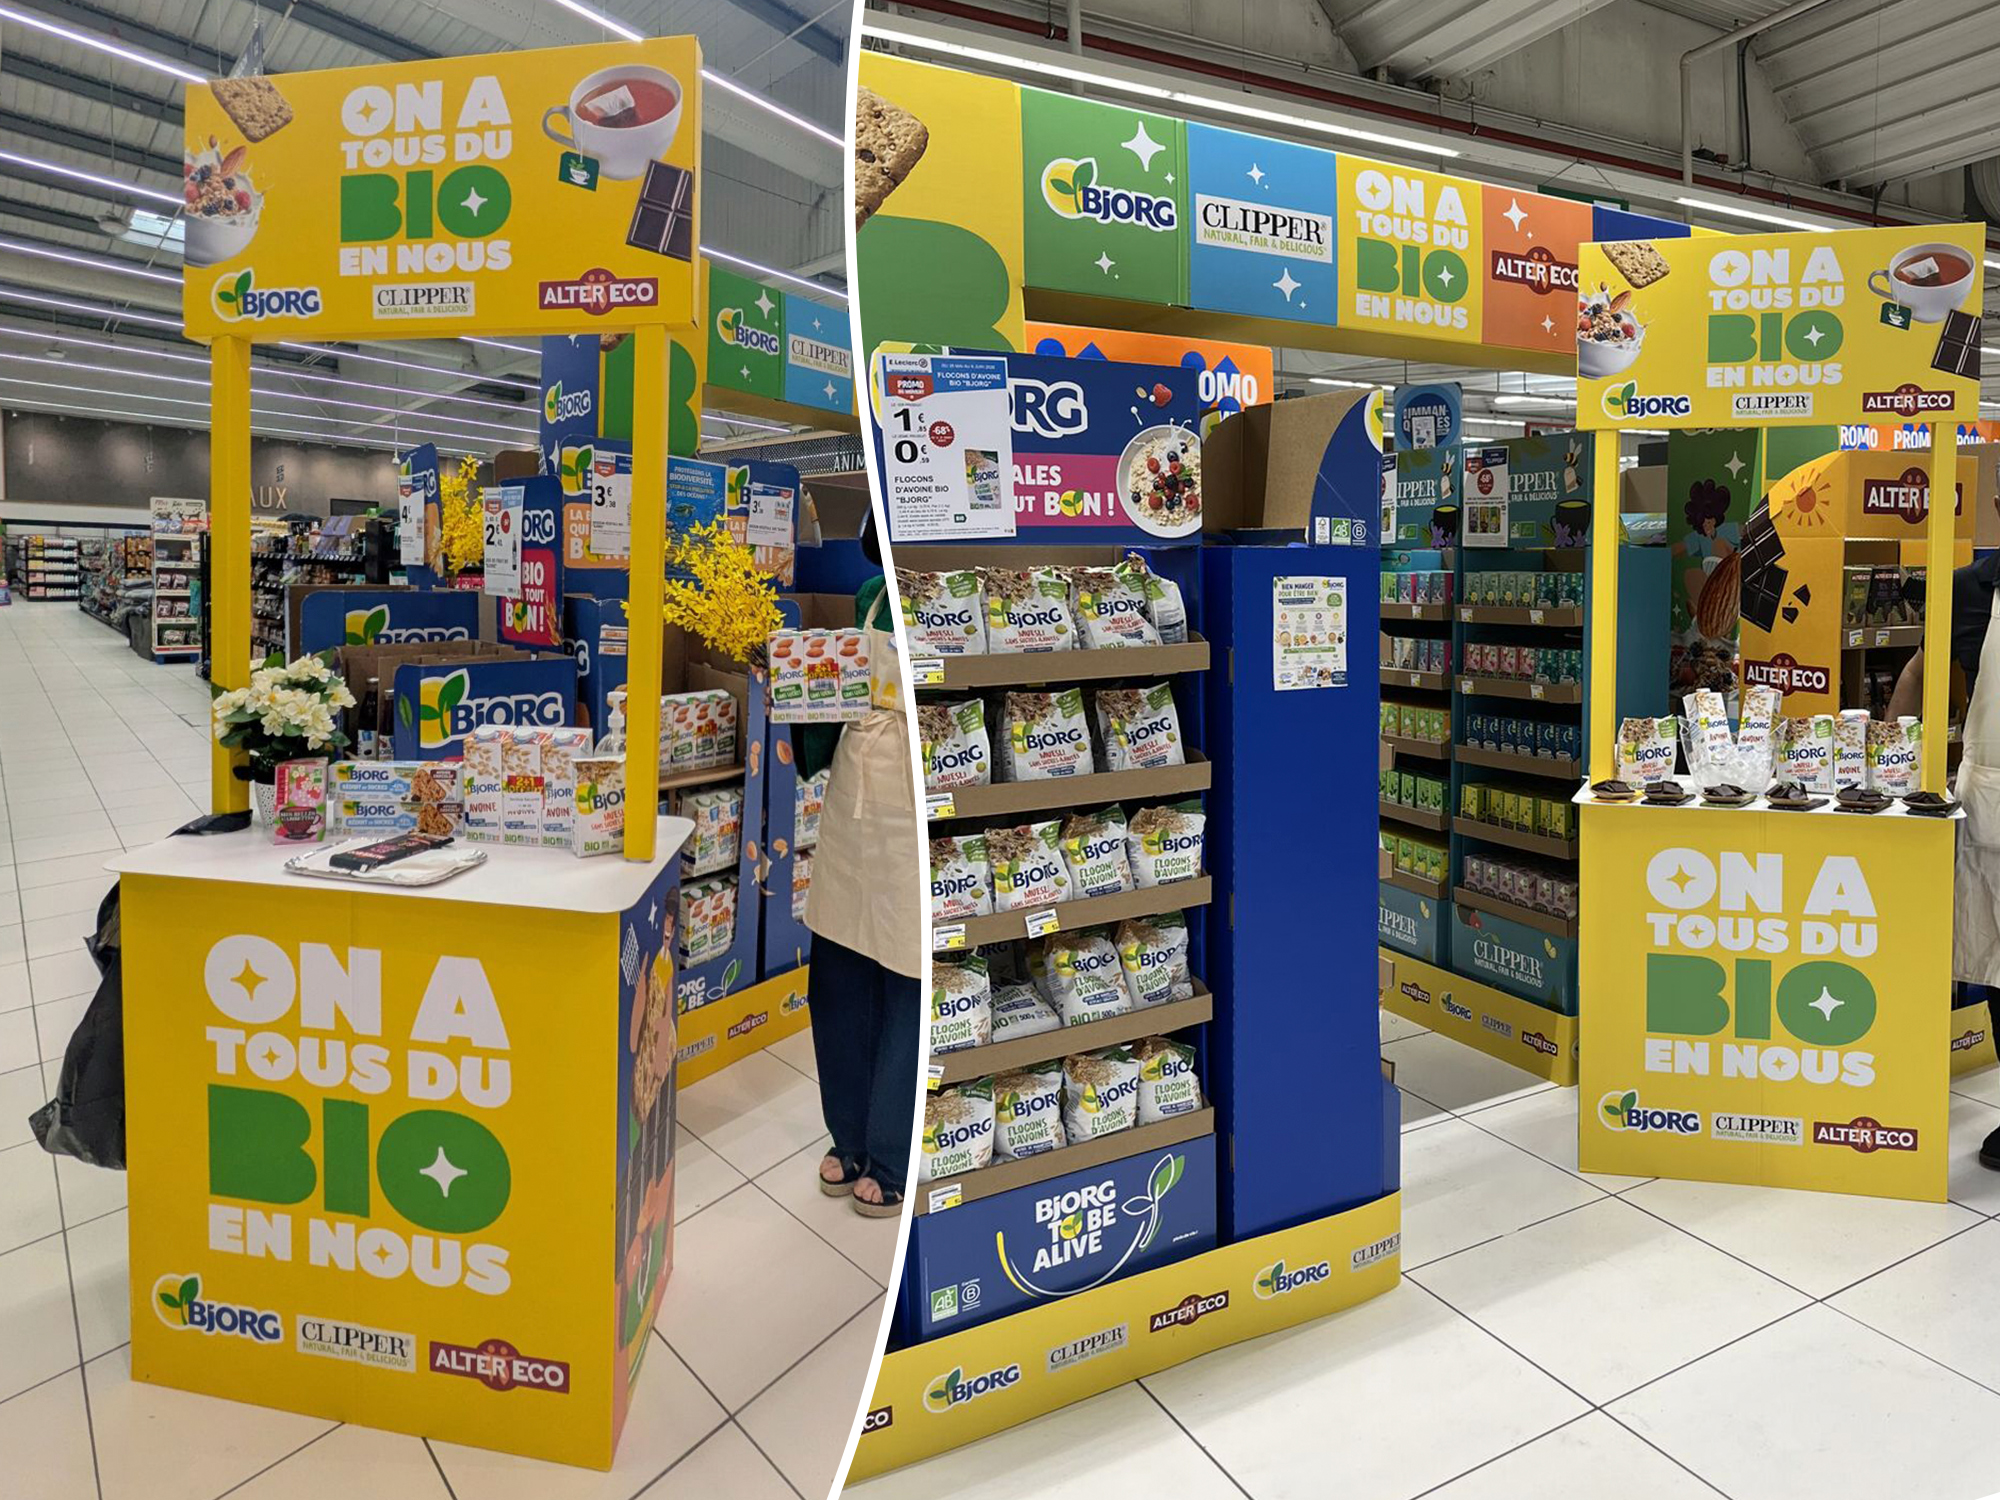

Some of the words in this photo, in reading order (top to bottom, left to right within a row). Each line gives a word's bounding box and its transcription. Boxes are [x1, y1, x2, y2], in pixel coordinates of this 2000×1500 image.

[341, 80, 442, 136] ON
[457, 75, 511, 128] A
[341, 135, 447, 170] TOUS
[454, 129, 512, 161] DU
[340, 165, 511, 242] BIO
[1355, 169, 1424, 219] ON
[1434, 186, 1468, 226] A
[1204, 229, 1248, 246] NATURAL,
[1250, 235, 1269, 247] FAIR
[1271, 239, 1278, 249] &
[1280, 240, 1325, 256] DELICIOUS
[1356, 211, 1428, 242] TOUS
[1433, 224, 1468, 250] DU
[339, 245, 388, 276] EN
[397, 240, 511, 274] NOUS
[1357, 237, 1469, 303] BIO
[1496, 257, 1546, 282] ALTER
[1709, 249, 1789, 286] ON
[1801, 246, 1844, 285] A
[544, 285, 605, 304] ALTER
[609, 283, 654, 302] ECO
[1709, 288, 1793, 310] TOUS
[1799, 285, 1846, 307] DU
[1356, 294, 1390, 320] EN
[1395, 299, 1468, 329] NOUS
[1708, 310, 1844, 363] BIO
[971, 373, 1001, 381] D'AVOINE
[1199, 372, 1258, 405] OMO
[1706, 366, 1745, 388] EN
[1752, 363, 1843, 387] NOUS
[1867, 395, 1912, 409] ALTER
[1917, 393, 1952, 408] ECO
[893, 408, 911, 432] 1
[918, 412, 925, 424] €
[894, 440, 919, 463] 0
[920, 445, 928, 456] €
[894, 476, 934, 484] FLOCONS
[895, 486, 933, 494] D'AVOINE
[934, 485, 949, 493] BIO
[1868, 487, 1919, 509] ALTER
[1747, 666, 1789, 685] ALTER
[1791, 669, 1826, 690] ECO
[1646, 847, 1783, 913] ON
[1803, 856, 1877, 917] A
[1379, 907, 1417, 936] IPPER
[1646, 912, 1789, 953] TOUS
[1801, 920, 1877, 957] DU
[204, 934, 381, 1036] ON
[410, 955, 511, 1050] A
[1646, 953, 1876, 1046] BIO
[729, 1018, 751, 1038] ALTER
[751, 1013, 767, 1028] ECO
[206, 1027, 391, 1095] TOUS
[407, 1051, 512, 1109] DU
[1645, 1038, 1709, 1076] EN
[1722, 1044, 1875, 1087] NOUS
[1817, 1127, 1871, 1144] ALTER
[1875, 1131, 1914, 1147] ECO
[208, 1083, 511, 1234] BIO
[1087, 1203, 1116, 1231] BE
[208, 1204, 292, 1261] EN
[309, 1219, 511, 1296] NOUS
[1032, 1230, 1102, 1273] ALIVE
[1153, 1305, 1194, 1329] ALTER
[1197, 1295, 1226, 1314] ECO
[435, 1349, 505, 1376] ALTER
[512, 1361, 564, 1387] ECO
